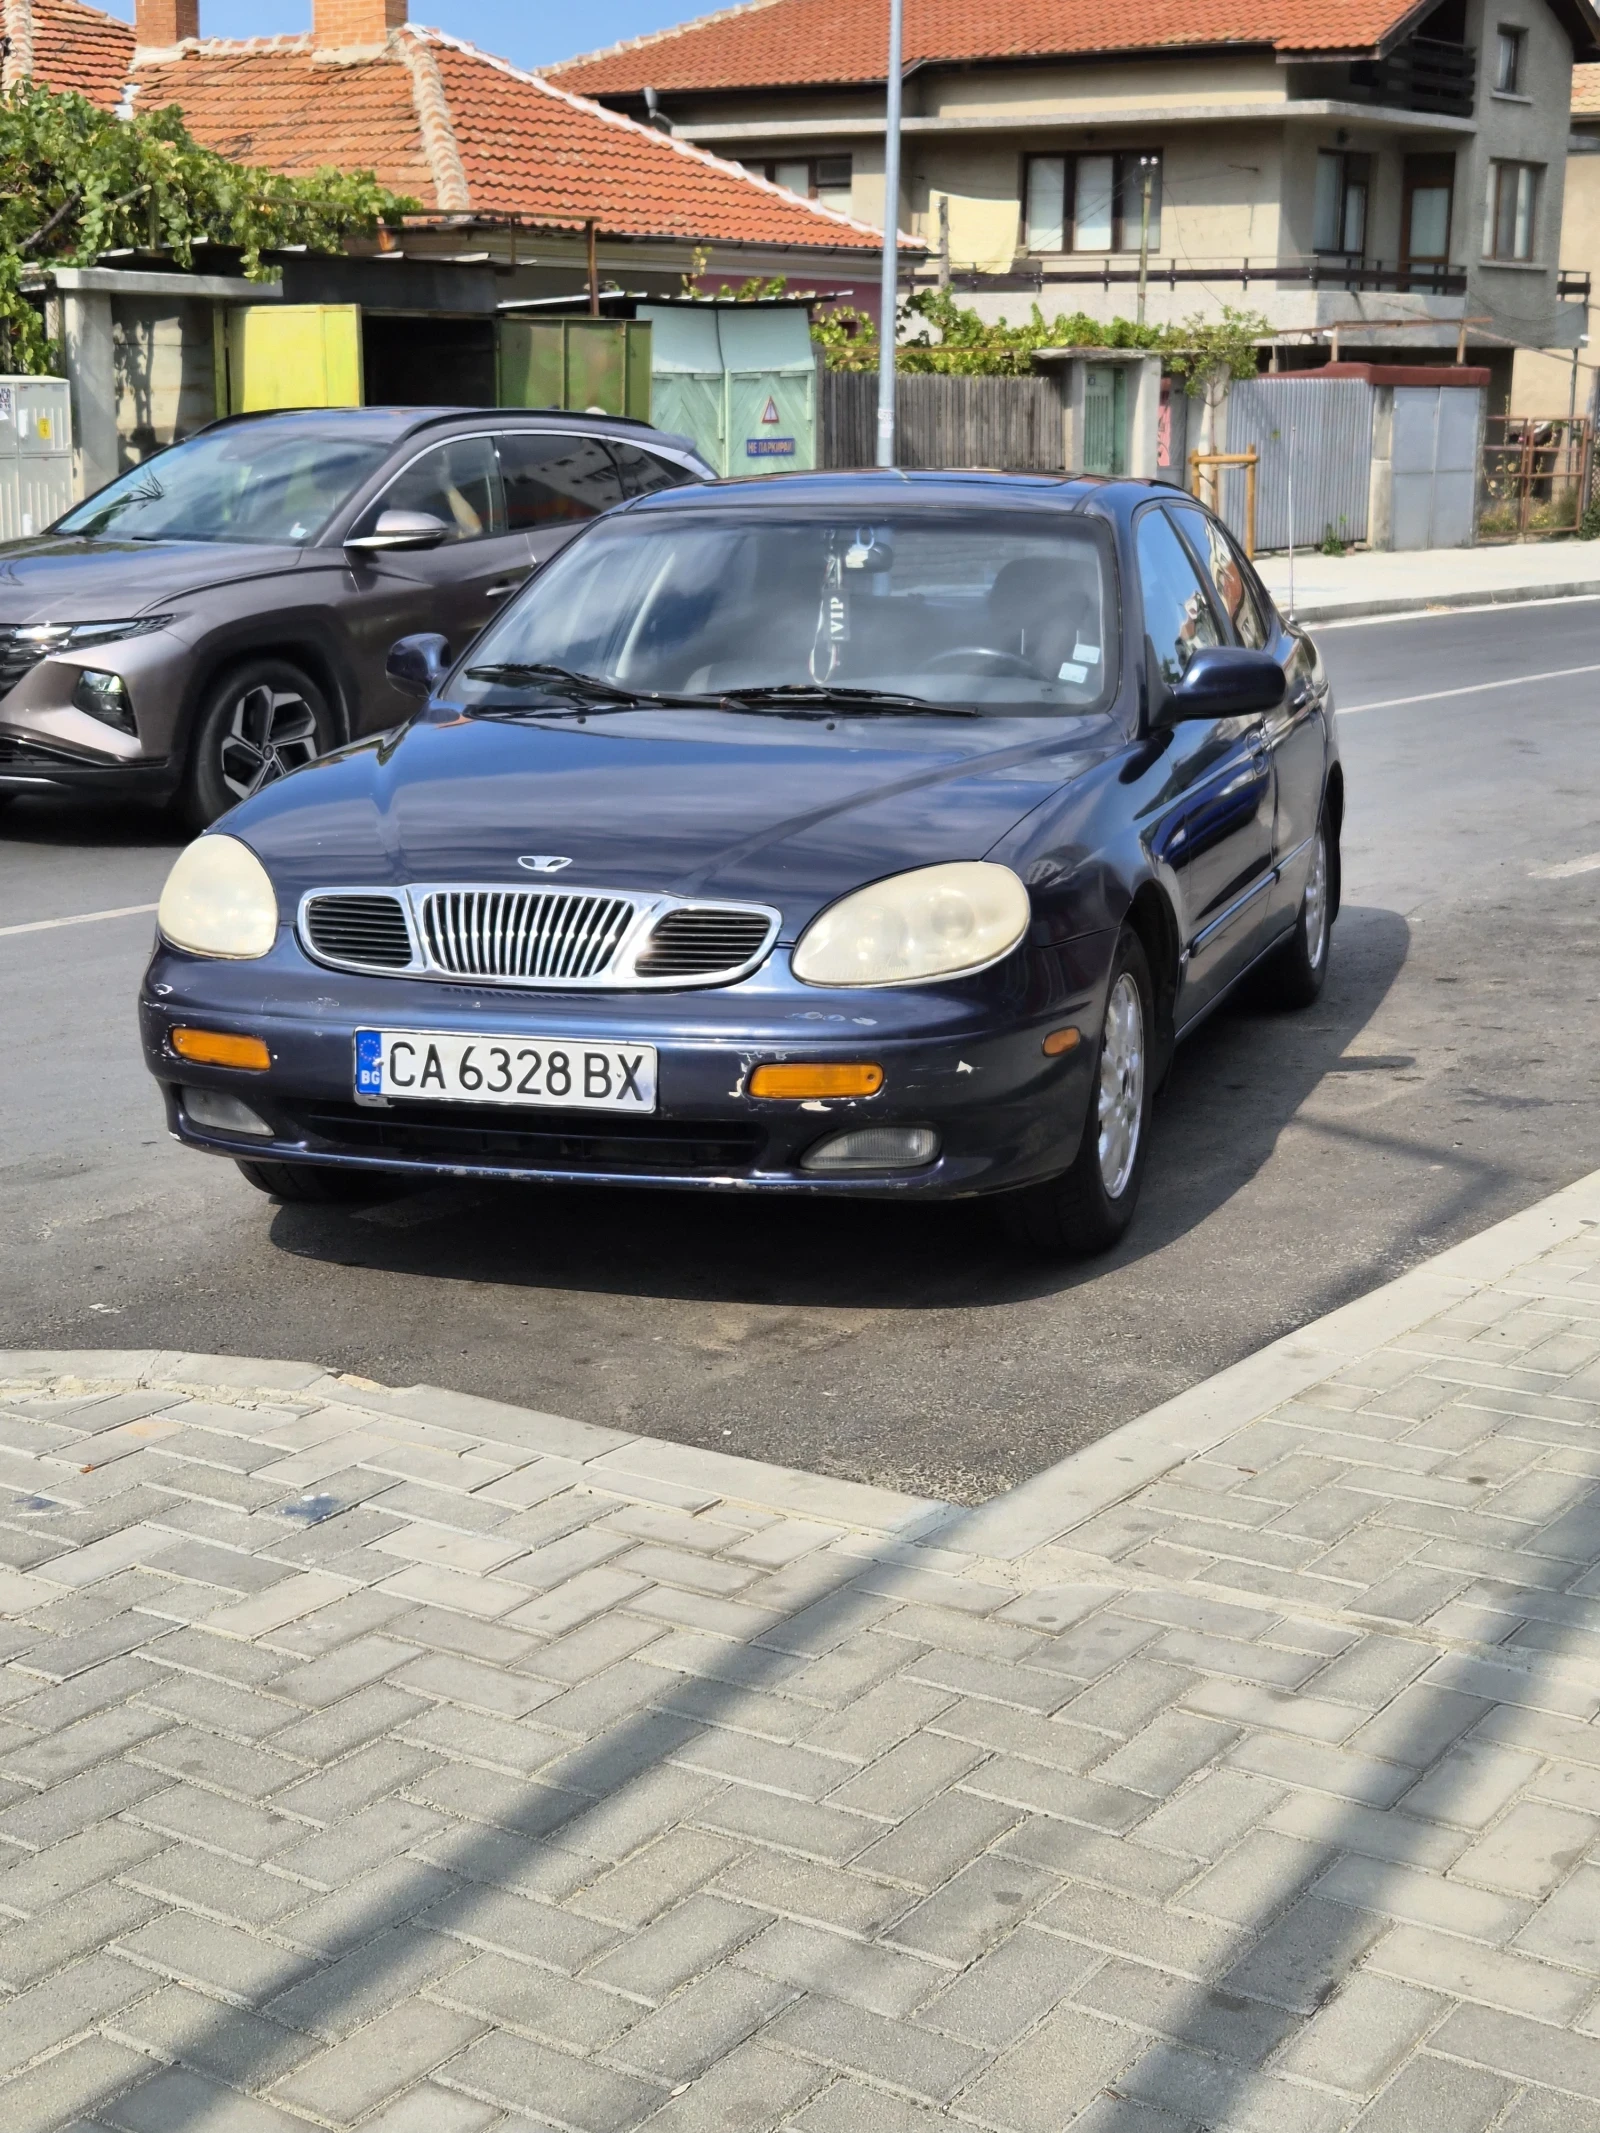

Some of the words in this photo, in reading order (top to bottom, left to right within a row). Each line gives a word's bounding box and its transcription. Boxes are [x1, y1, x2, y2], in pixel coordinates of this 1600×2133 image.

[748, 441, 757, 454] НЕ
[830, 597, 844, 634] VIP
[361, 1070, 380, 1085] BG
[459, 1044, 572, 1097] 6328
